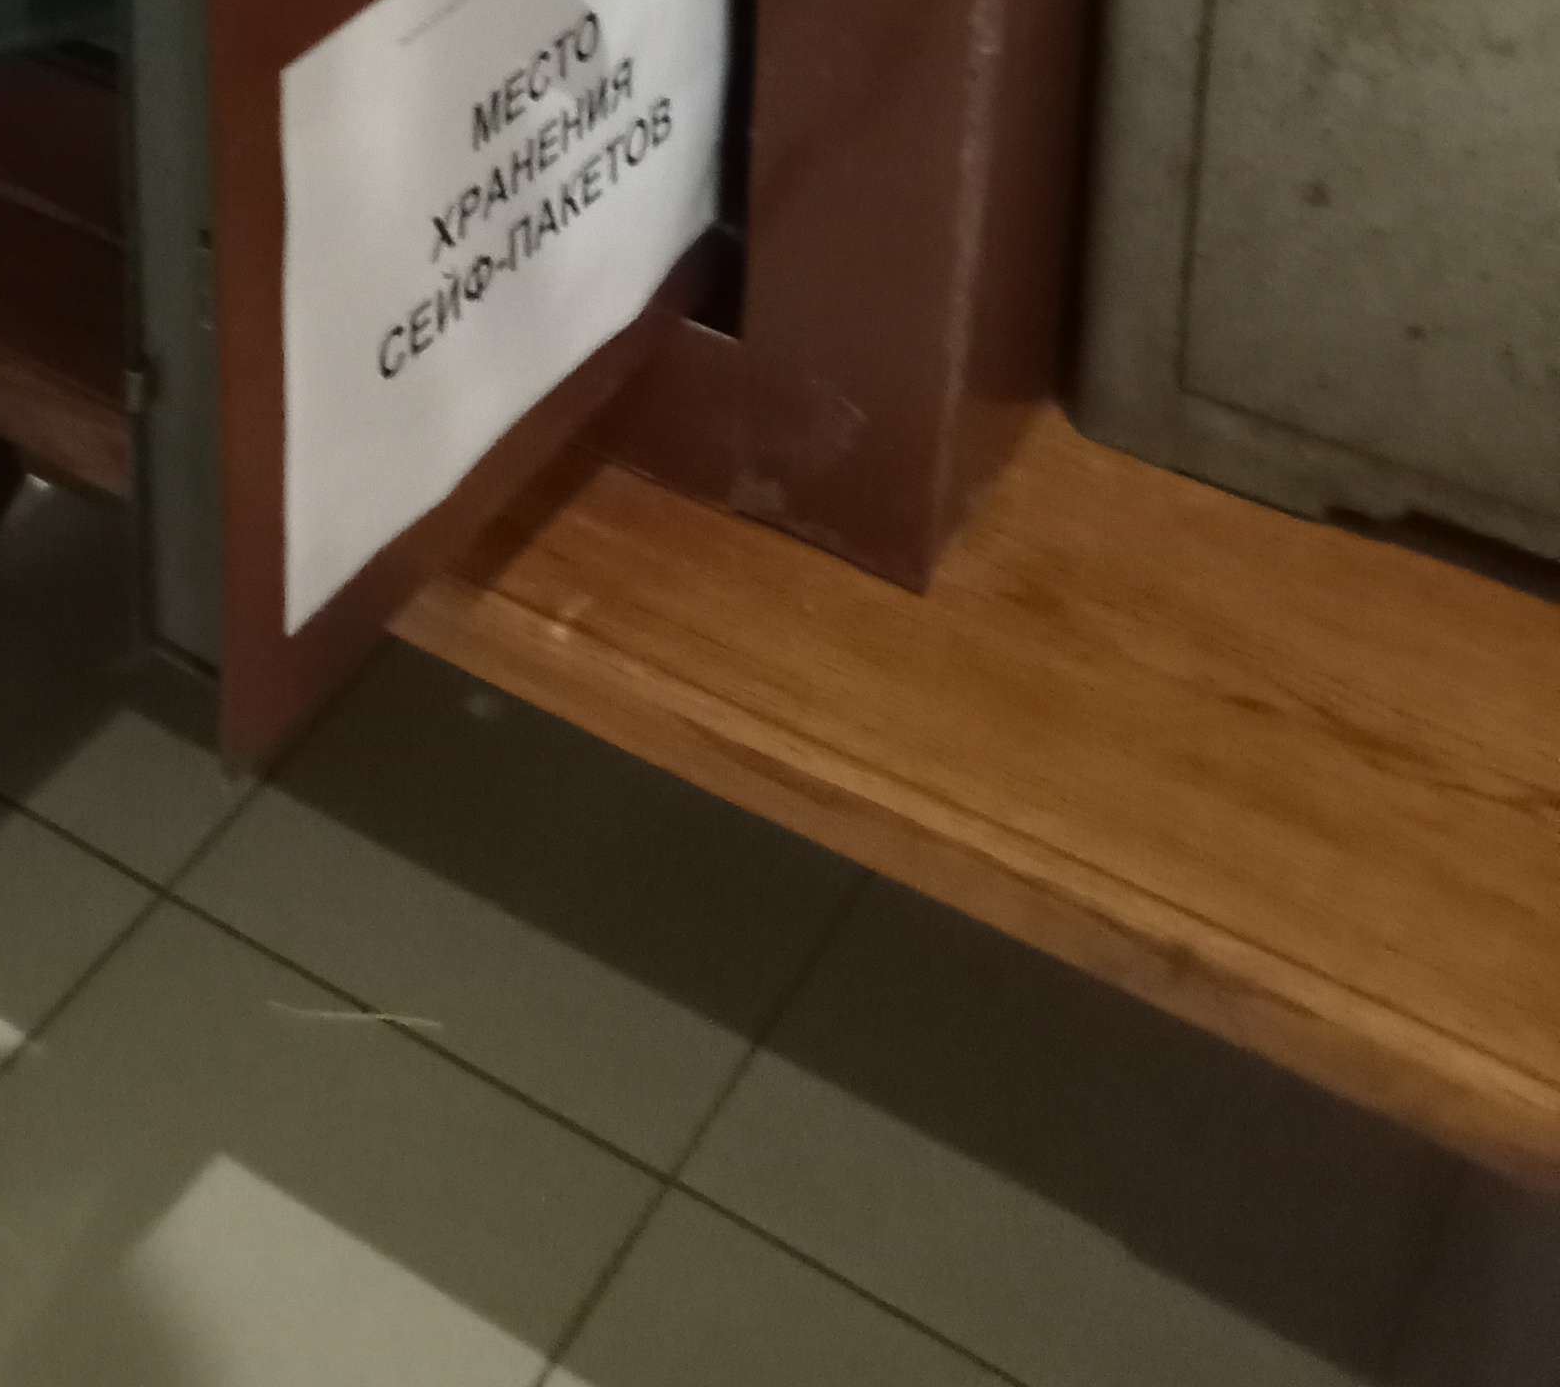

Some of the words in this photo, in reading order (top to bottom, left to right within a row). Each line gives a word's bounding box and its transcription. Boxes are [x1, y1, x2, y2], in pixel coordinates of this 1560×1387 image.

[430, 56, 634, 264] ХРАНЕНИЯ
[471, 11, 601, 151] МЕСТО
[378, 95, 673, 380] СЕЙФ-ПАКЕТОВ
